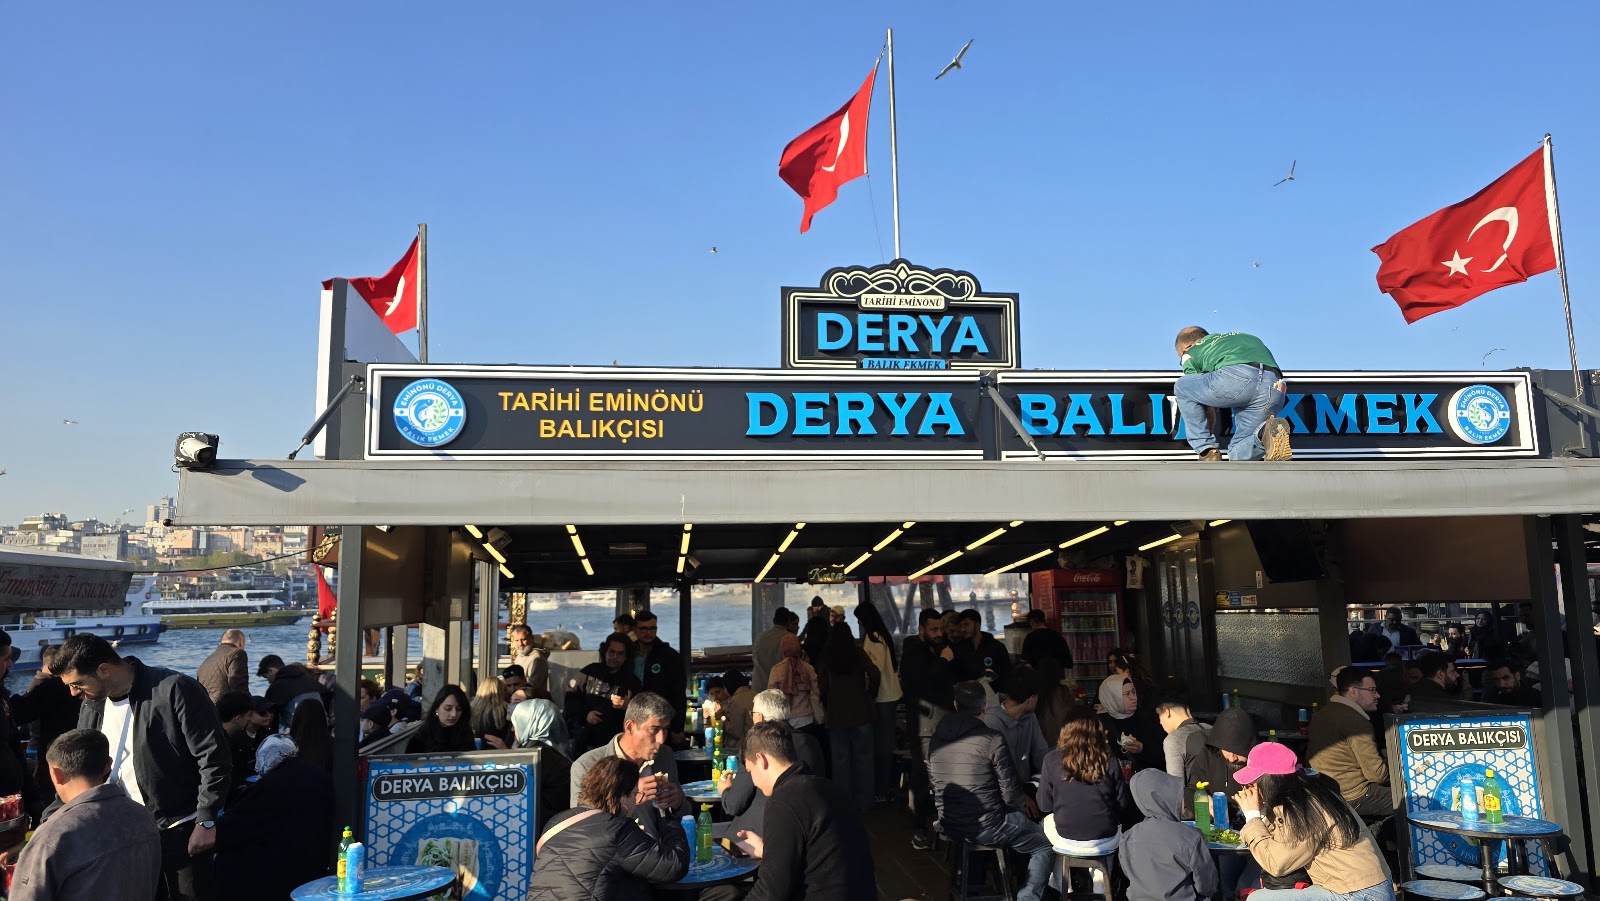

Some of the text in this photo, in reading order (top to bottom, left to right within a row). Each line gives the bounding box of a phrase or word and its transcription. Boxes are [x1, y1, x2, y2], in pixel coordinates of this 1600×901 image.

[864, 296, 943, 307] TARİHİ EMİNÖNÜ
[817, 312, 989, 353] DERYA
[868, 360, 941, 369] BALIK EKMEK
[400, 383, 458, 407] EMİNÖNÜ DERYA
[497, 387, 704, 413] TARİHİ EMİNÖNÜ
[1487, 390, 1505, 409] DERYA
[745, 392, 966, 436] DERYA
[1231, 393, 1444, 434] KMEK
[402, 426, 455, 442] BALIK EKMEK
[539, 419, 664, 443] BALIKÇISI
[1464, 425, 1505, 441] BALIK EKMEK
[808, 567, 844, 580] Kasa
[1413, 730, 1521, 747] DERYA BALIKÇISI
[380, 773, 518, 795] DERYA BALIKÇISI
[1460, 849, 1478, 862] FISH
